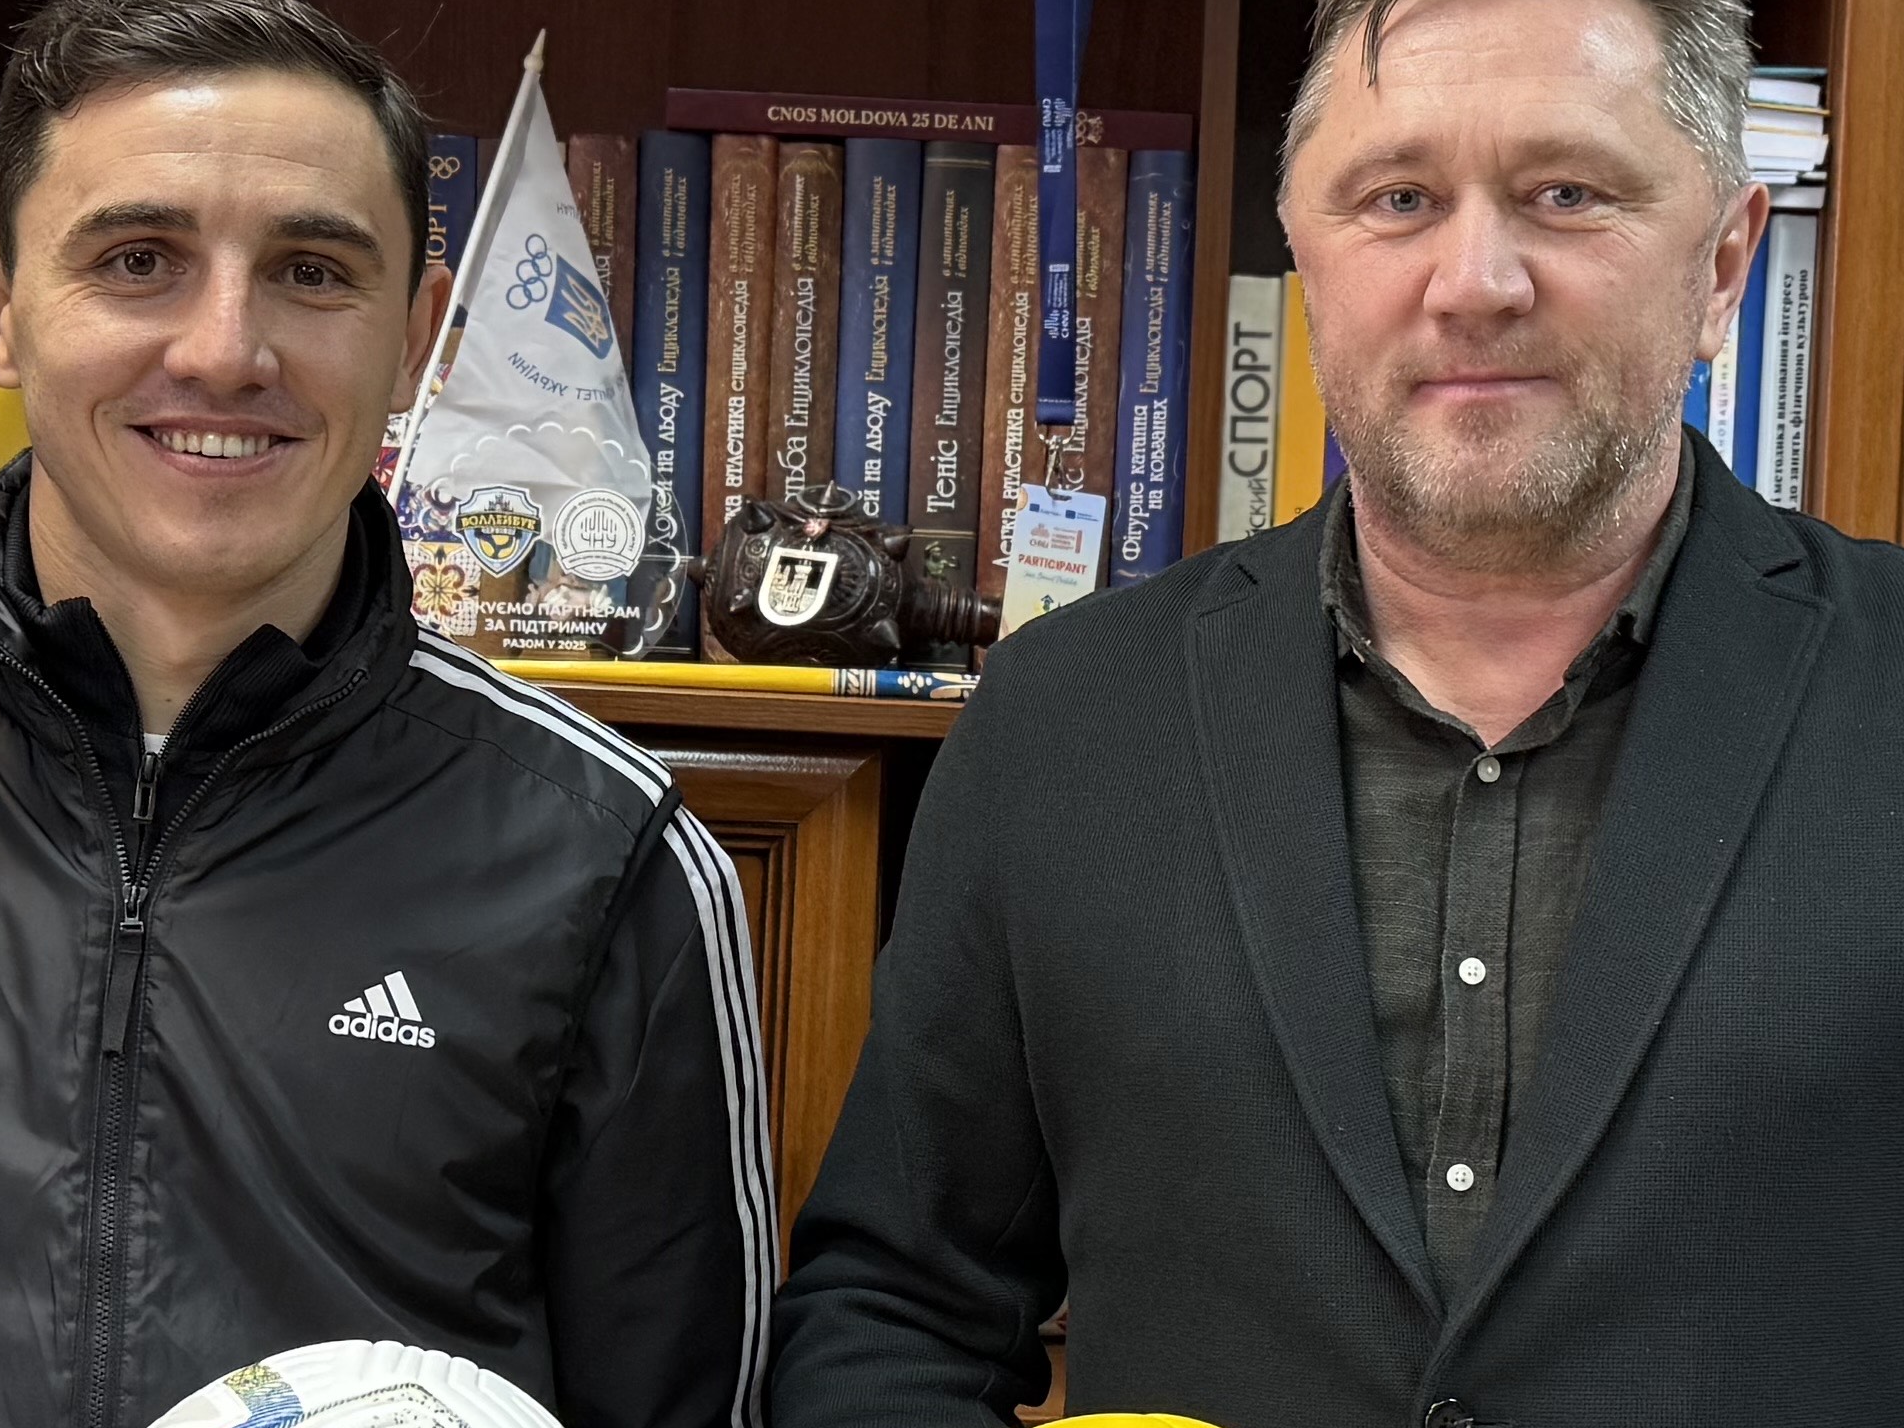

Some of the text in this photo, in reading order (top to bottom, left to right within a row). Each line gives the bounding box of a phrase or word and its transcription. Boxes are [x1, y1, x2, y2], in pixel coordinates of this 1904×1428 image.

[767, 105, 994, 132] CNOS MOLDOVA 25 DE ANI
[657, 267, 681, 373] Енциклопедія
[730, 280, 750, 392] енциклопедія
[784, 277, 817, 427] Енциклопедія
[865, 275, 890, 382] Енциклопедія
[1009, 291, 1031, 404] енциклопедія
[1139, 286, 1166, 394] Енциклопедія
[1794, 269, 1809, 350] культурою
[659, 382, 684, 444] льоду
[865, 391, 892, 453] льоду
[926, 291, 966, 513] Теніс Енциклопедія
[1227, 320, 1273, 478] СПОРТ
[1773, 274, 1793, 494] методика виховання інтересу
[1789, 354, 1805, 428] фізичною
[657, 450, 674, 473] на
[725, 395, 745, 488] атлетика
[864, 459, 882, 482] на
[1000, 407, 1024, 501] атлетика
[1122, 404, 1150, 562] Фігурне катання
[1148, 397, 1168, 510] на ковзанах
[1018, 553, 1088, 575] PARTICIPANT
[484, 618, 607, 636] ЗА ПІДТРИМКУ
[502, 638, 545, 650] РАЗОМ
[328, 1012, 436, 1048] adidas
